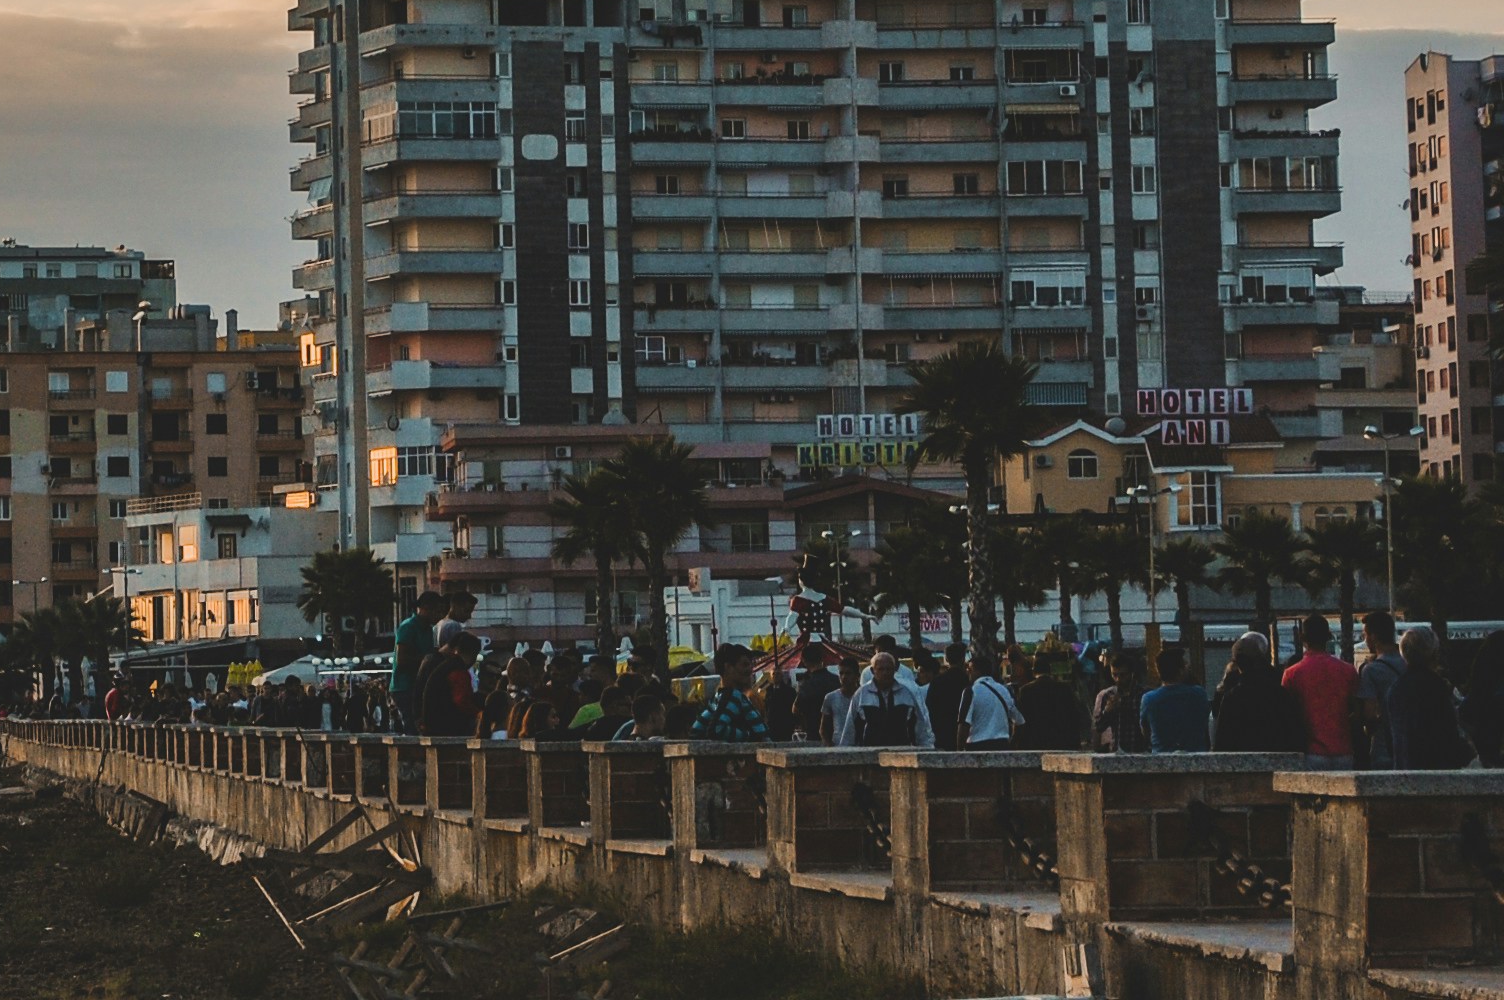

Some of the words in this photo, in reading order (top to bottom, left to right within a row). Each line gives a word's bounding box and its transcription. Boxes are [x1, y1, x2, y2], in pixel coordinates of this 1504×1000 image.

[1139, 390, 1249, 413] HOTEL
[818, 415, 916, 436] HOTEL
[1164, 421, 1224, 443] ANI
[799, 443, 932, 465] KRISTA
